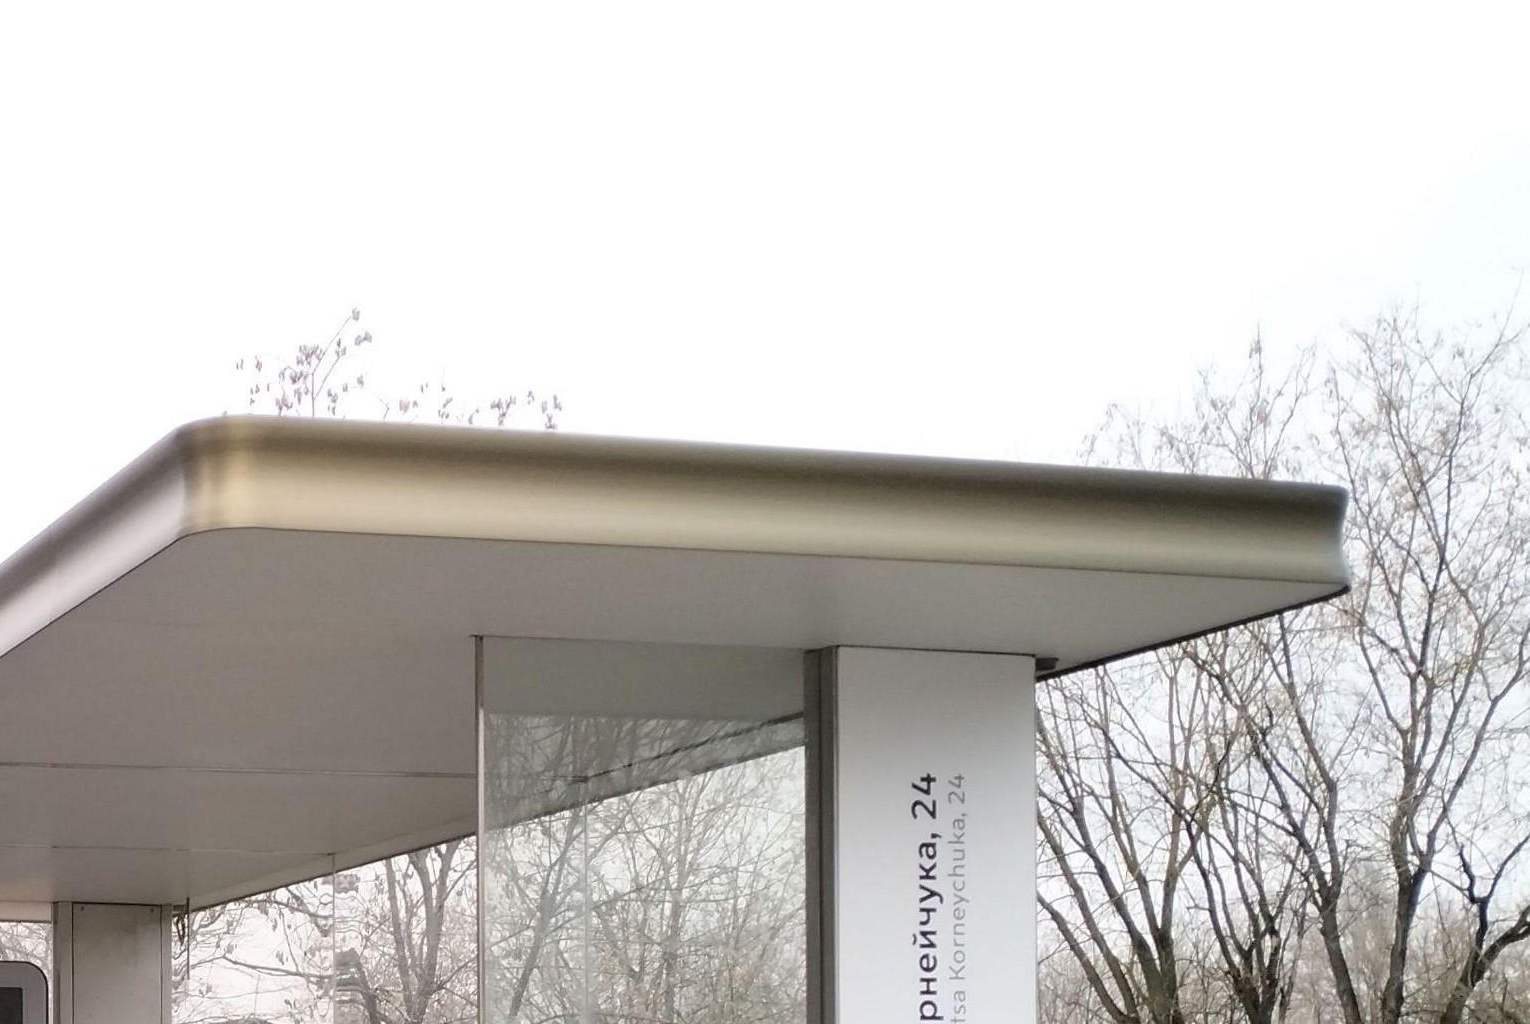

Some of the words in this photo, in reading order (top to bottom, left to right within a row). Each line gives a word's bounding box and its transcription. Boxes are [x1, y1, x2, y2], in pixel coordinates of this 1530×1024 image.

[911, 772, 938, 820] 24
[947, 773, 966, 805] 24
[947, 812, 969, 981] Korneychuka,
